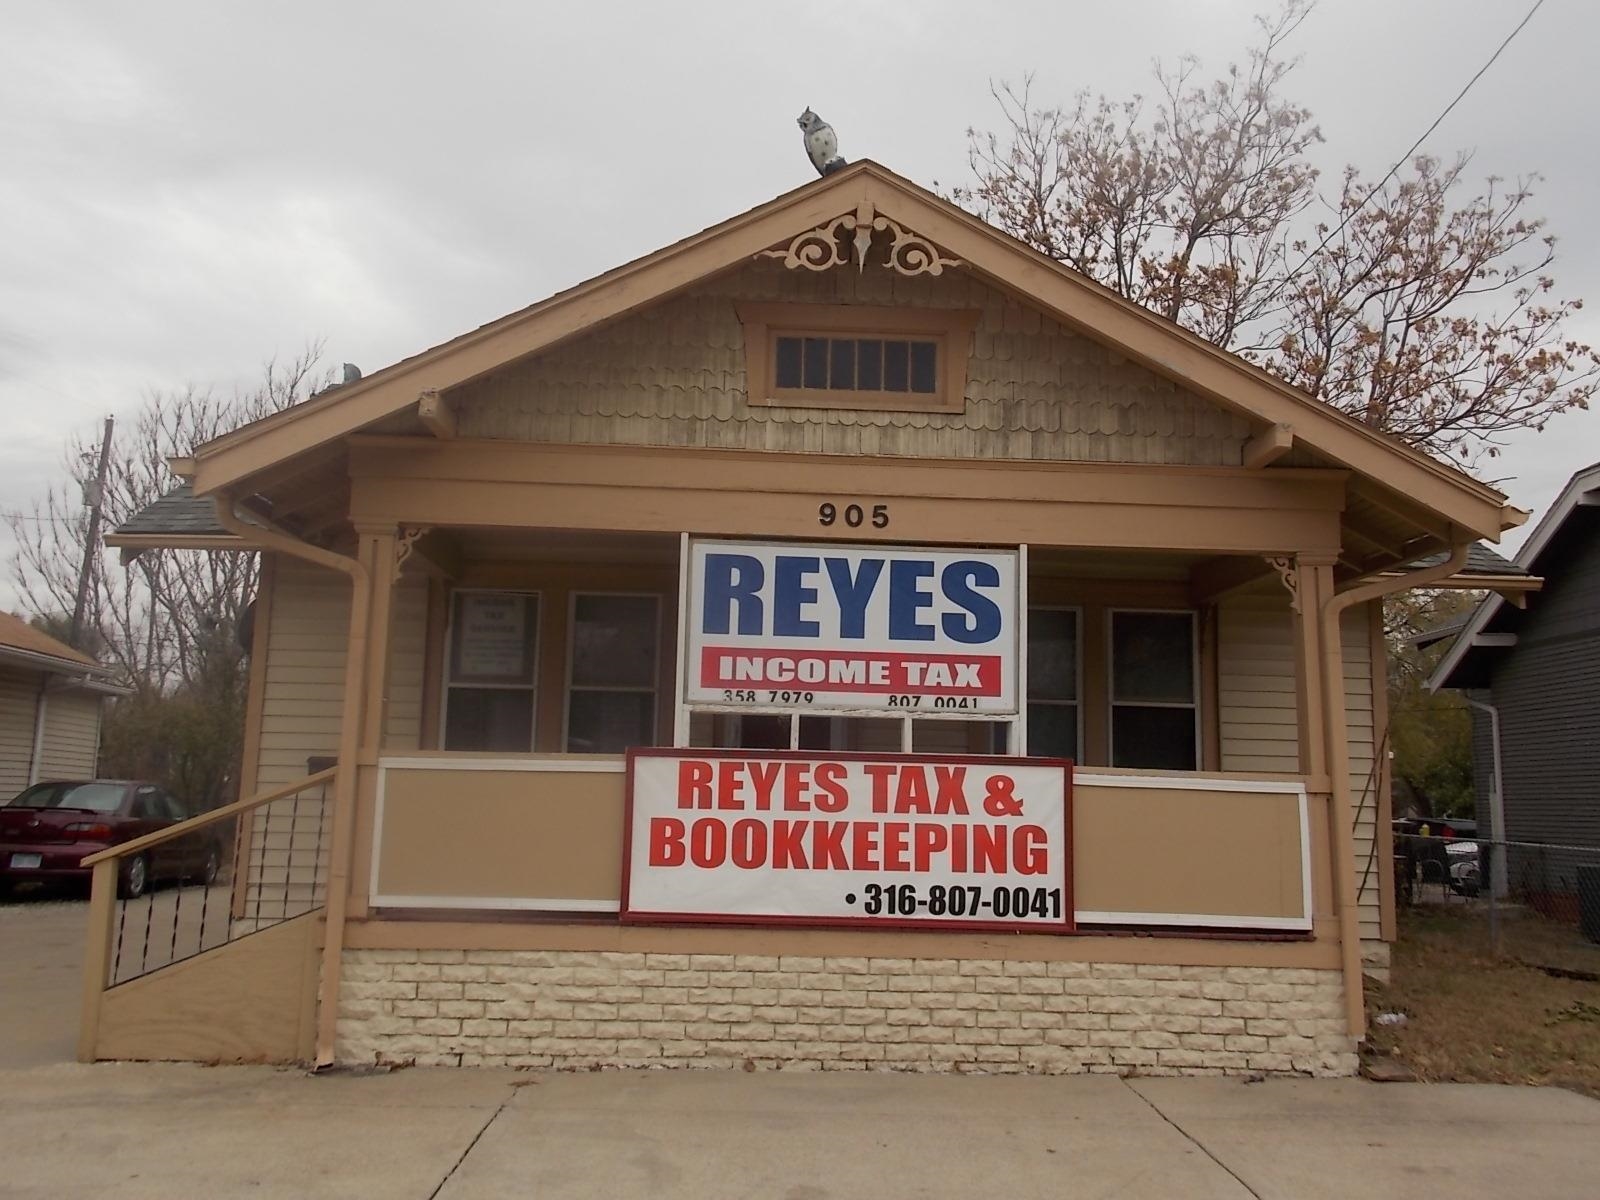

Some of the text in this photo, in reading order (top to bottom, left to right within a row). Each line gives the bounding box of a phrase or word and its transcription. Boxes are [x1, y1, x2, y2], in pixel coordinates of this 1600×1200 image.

[819, 502, 889, 528] 905
[702, 553, 1002, 644] REYES
[719, 656, 982, 688] INCOME TAX
[723, 689, 814, 704] 358 7979
[888, 695, 977, 709] 807 0041
[677, 760, 1024, 817] REYES TAX &
[649, 817, 1049, 875] BOOKKEEPING
[864, 883, 1061, 918] 316-807-0041
